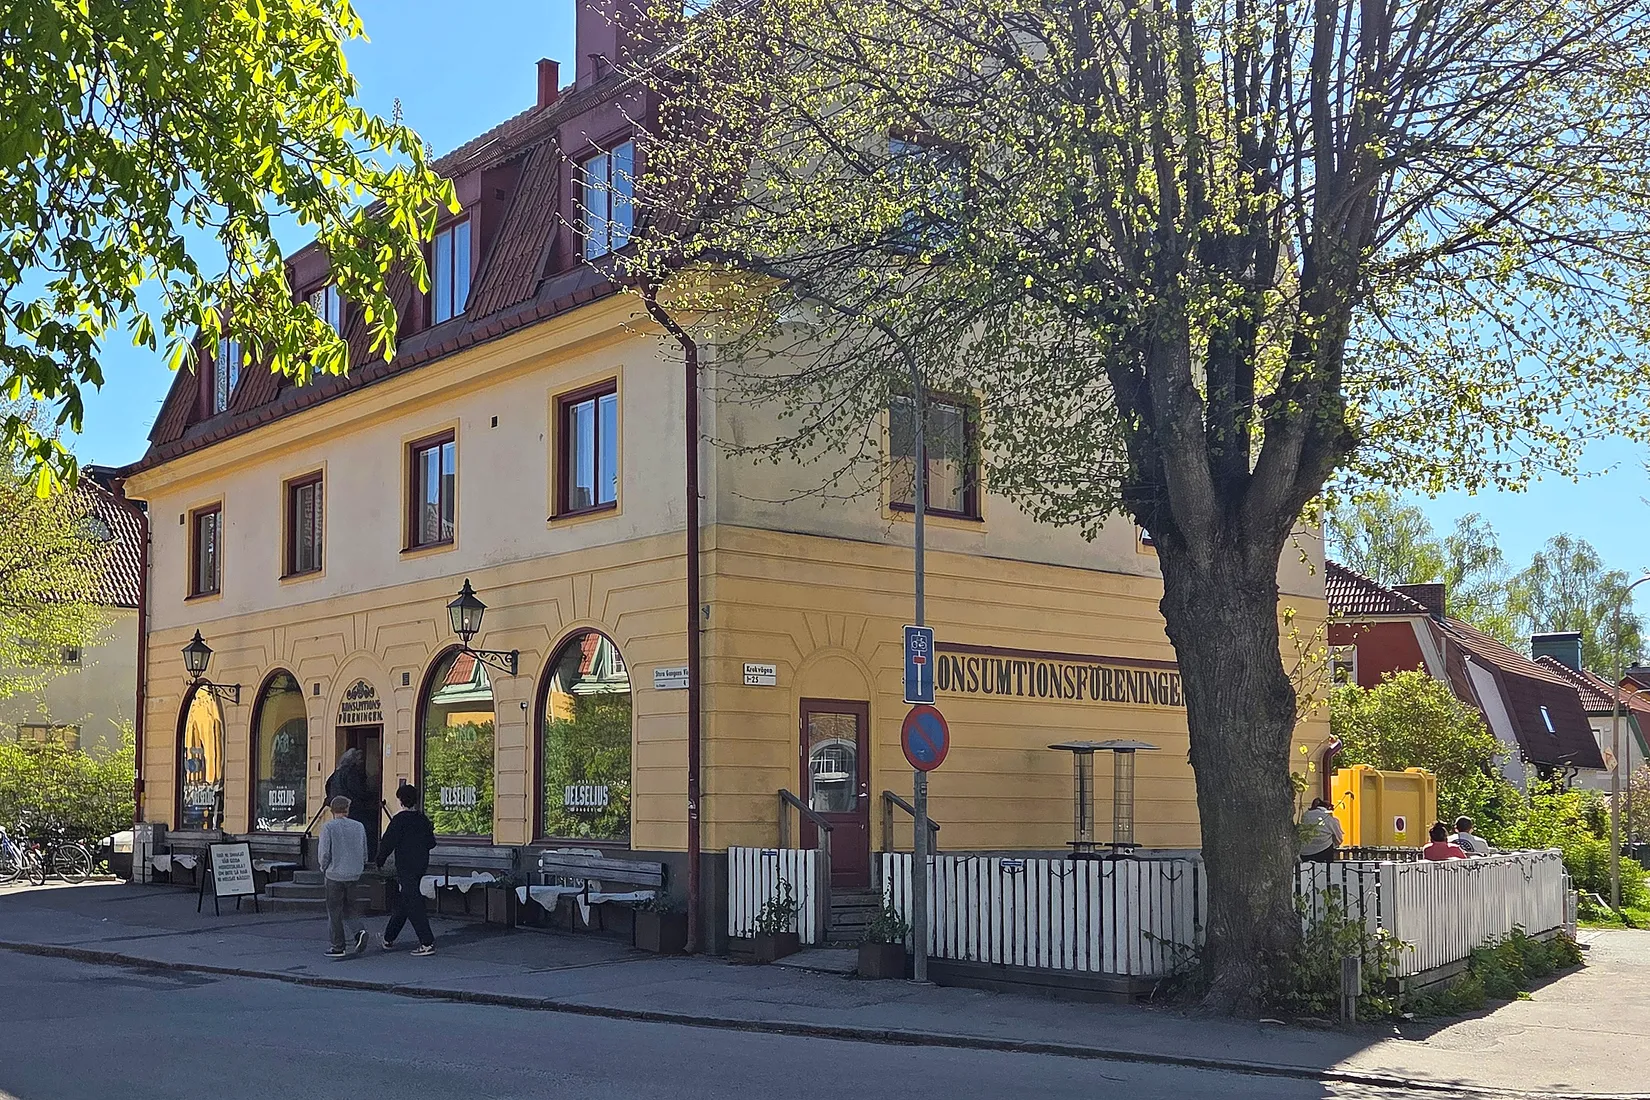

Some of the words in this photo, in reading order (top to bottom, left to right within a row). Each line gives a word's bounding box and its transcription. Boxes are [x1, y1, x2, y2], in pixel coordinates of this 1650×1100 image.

[746, 665, 773, 675] Krokvägen
[934, 654, 1186, 707] ONSUMTIONSFÖRENINGE
[269, 790, 295, 806] DELSELIUS
[440, 786, 476, 805] DELSELIUS
[565, 785, 608, 806] DELSELIUS
